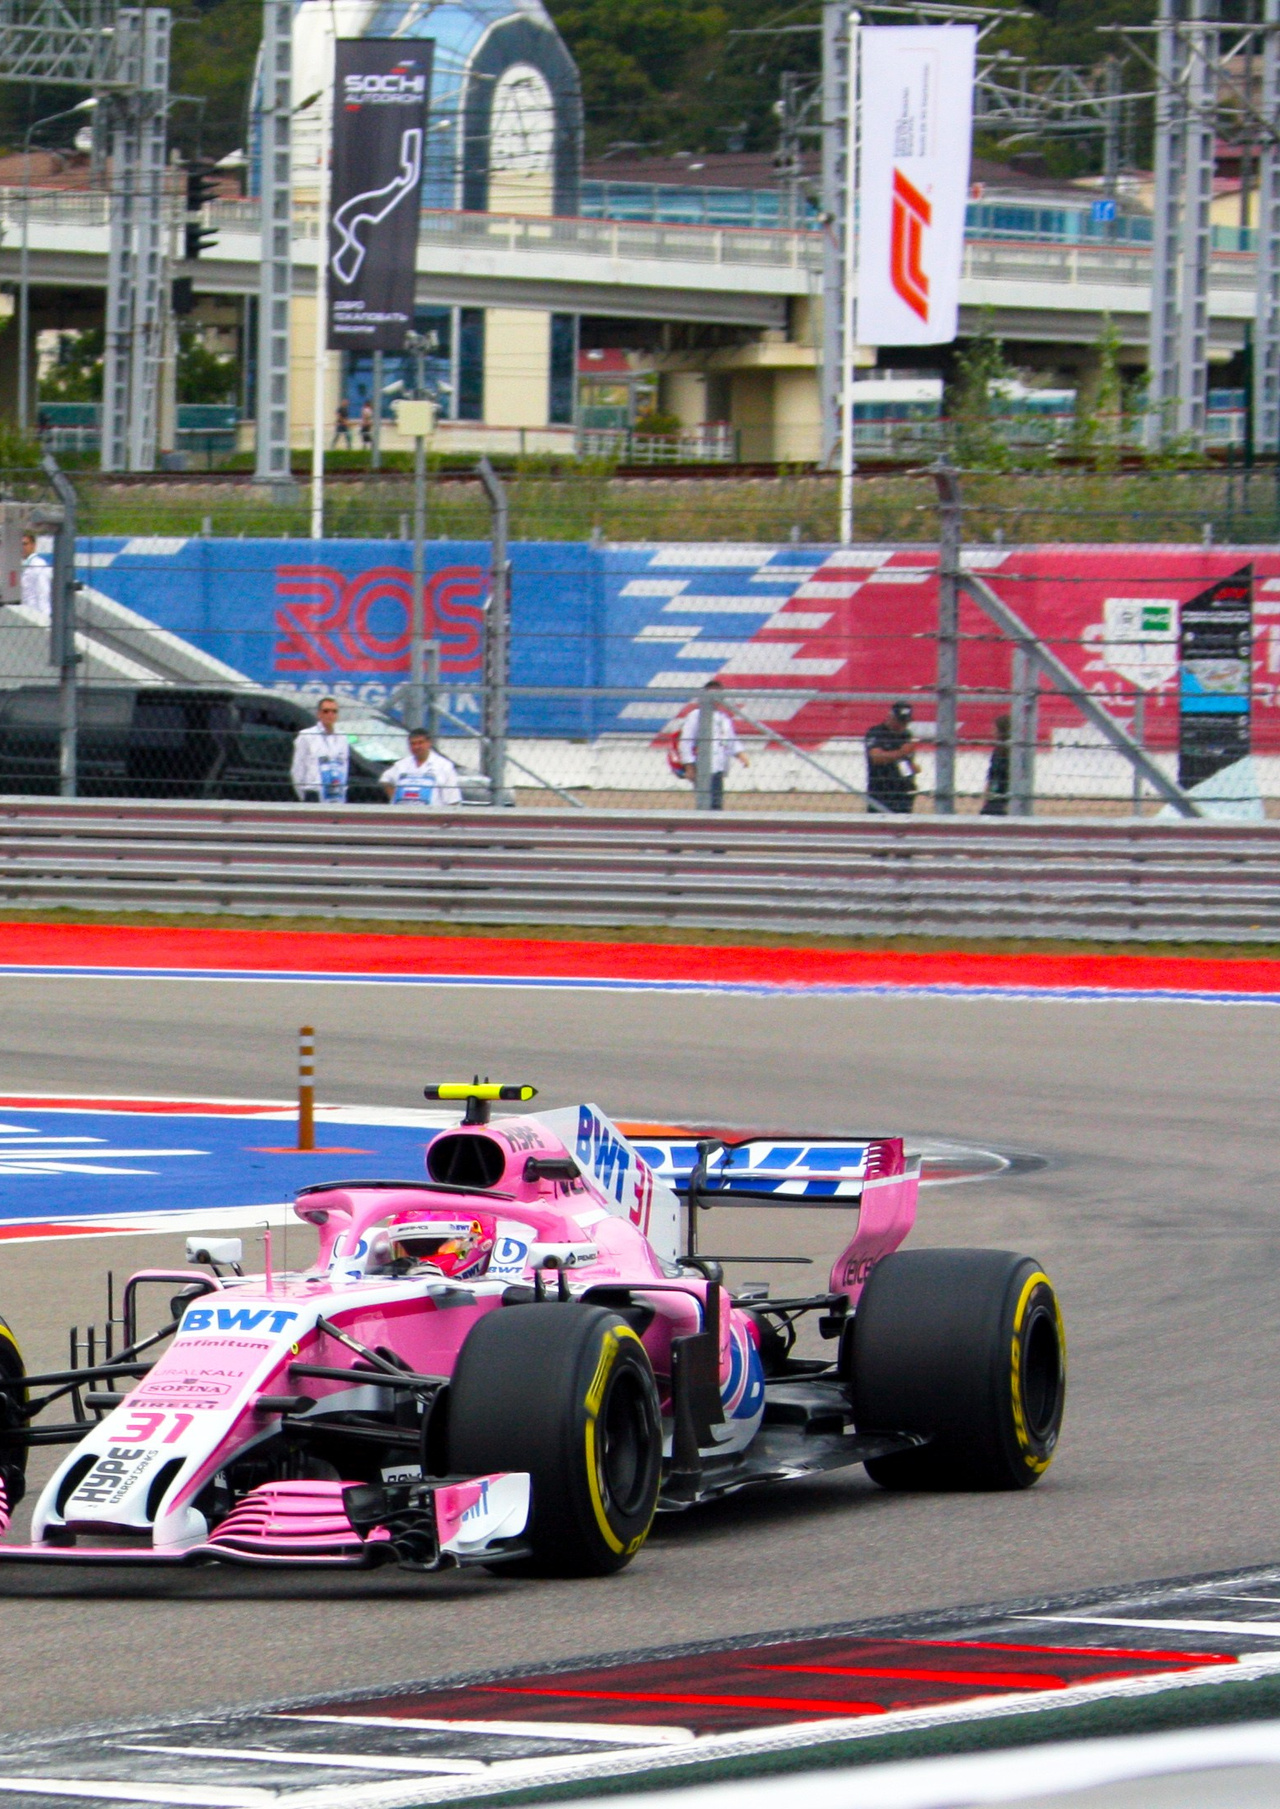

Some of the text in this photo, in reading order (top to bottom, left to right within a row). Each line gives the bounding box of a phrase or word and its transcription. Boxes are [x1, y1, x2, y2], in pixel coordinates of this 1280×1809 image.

[344, 74, 426, 92] SOCHI
[275, 565, 485, 673] ROS
[501, 1124, 546, 1154] HYPE
[576, 1104, 630, 1205] BWT
[488, 1266, 523, 1275] BWT
[181, 1309, 299, 1334] BWT
[173, 1339, 270, 1351] infinitum
[153, 1369, 245, 1378] URALKALI
[148, 1384, 221, 1394] SOFINA
[107, 1412, 195, 1444] 31
[72, 1447, 146, 1503] HYPE
[108, 1475, 139, 1504] ENERGY
